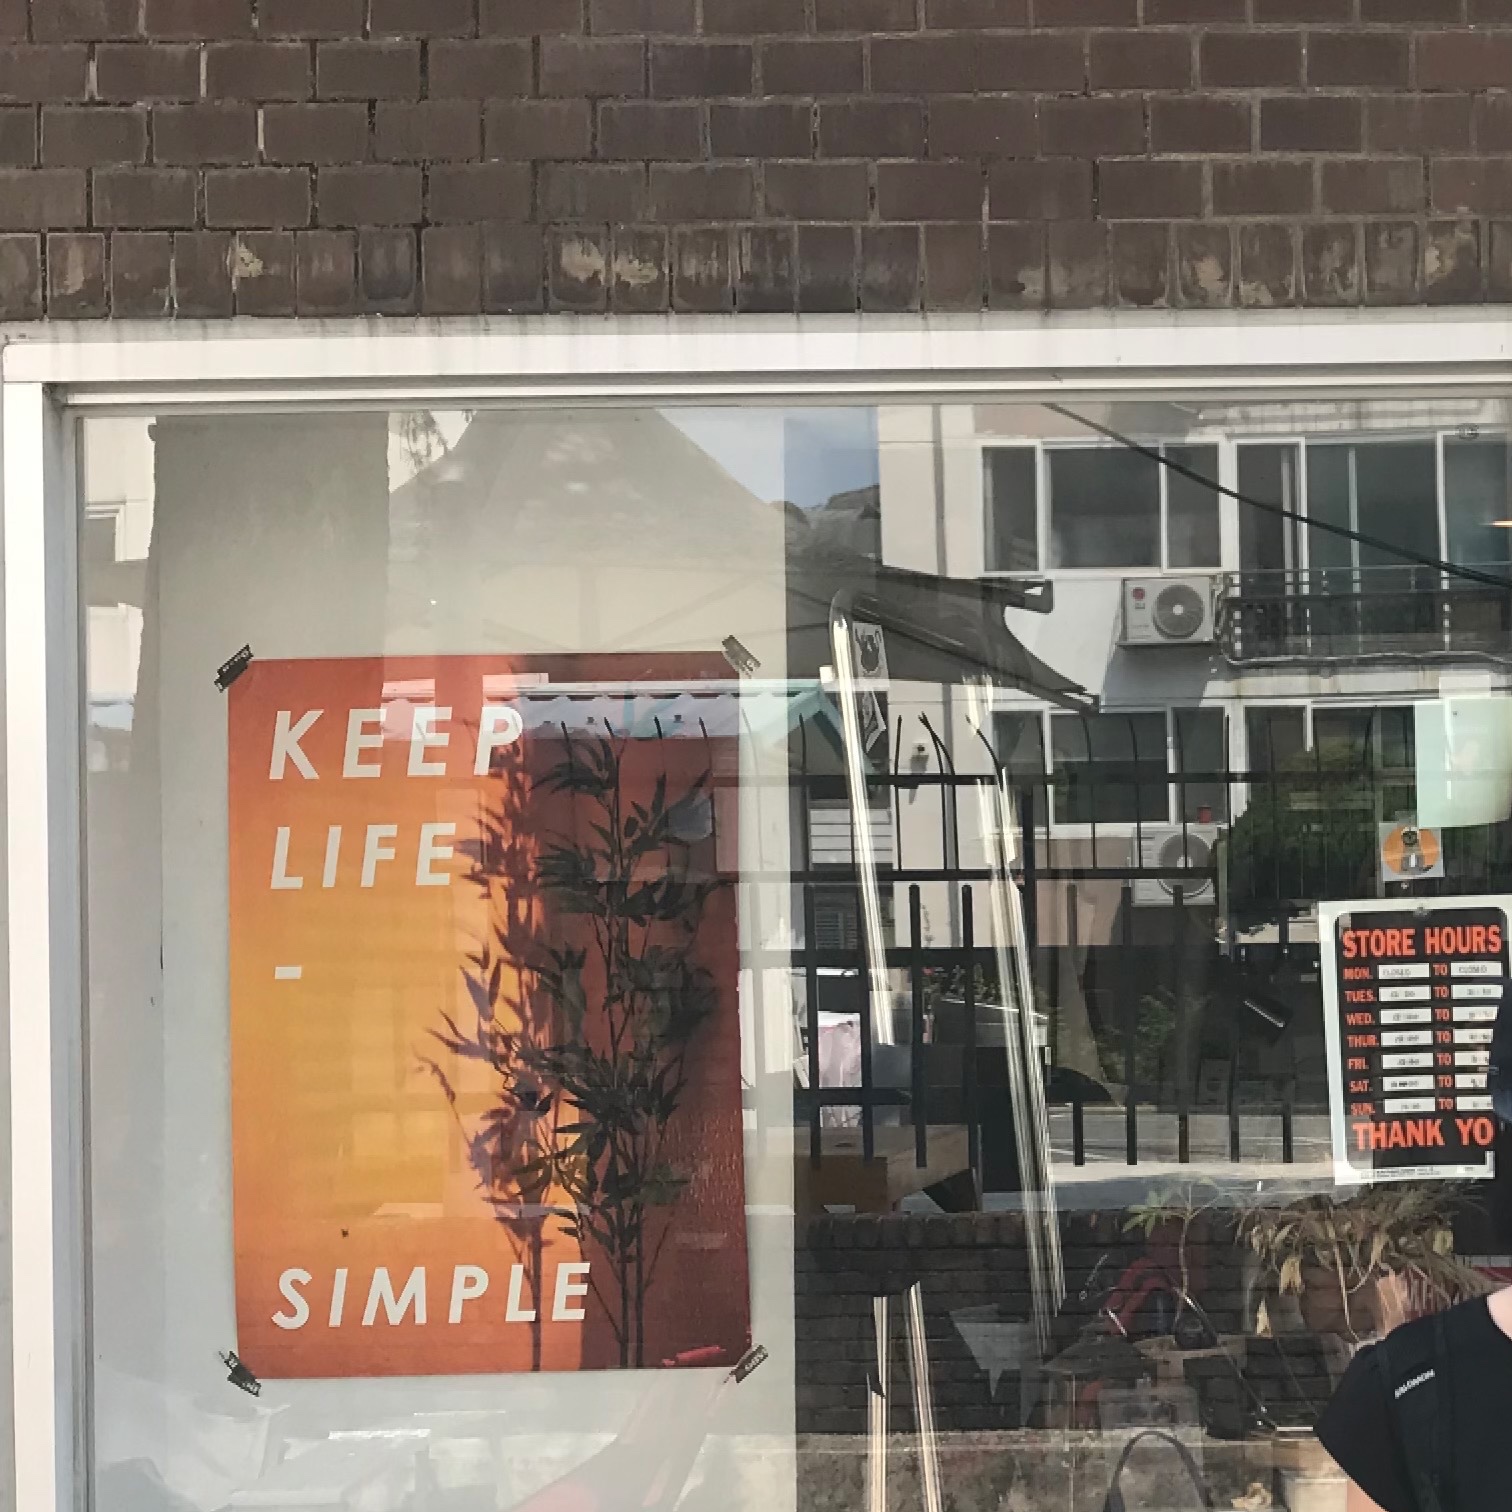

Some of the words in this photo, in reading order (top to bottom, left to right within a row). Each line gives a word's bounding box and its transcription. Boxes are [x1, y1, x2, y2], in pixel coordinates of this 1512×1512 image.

[270, 706, 525, 780] KEEP
[270, 822, 457, 890] LIFE
[1343, 929, 1416, 959] STORE
[1425, 925, 1502, 955] HOURS
[1433, 963, 1448, 976] TO
[1433, 985, 1449, 998] TO
[1435, 1008, 1450, 1021] TO
[1436, 1030, 1452, 1043] TO
[1437, 1052, 1452, 1066] TO
[1437, 1075, 1453, 1088] TO
[1438, 1097, 1454, 1110] TO
[1352, 1118, 1445, 1152] THANK
[1455, 1116, 1495, 1146] YO
[270, 1262, 591, 1330] SIMPLE
